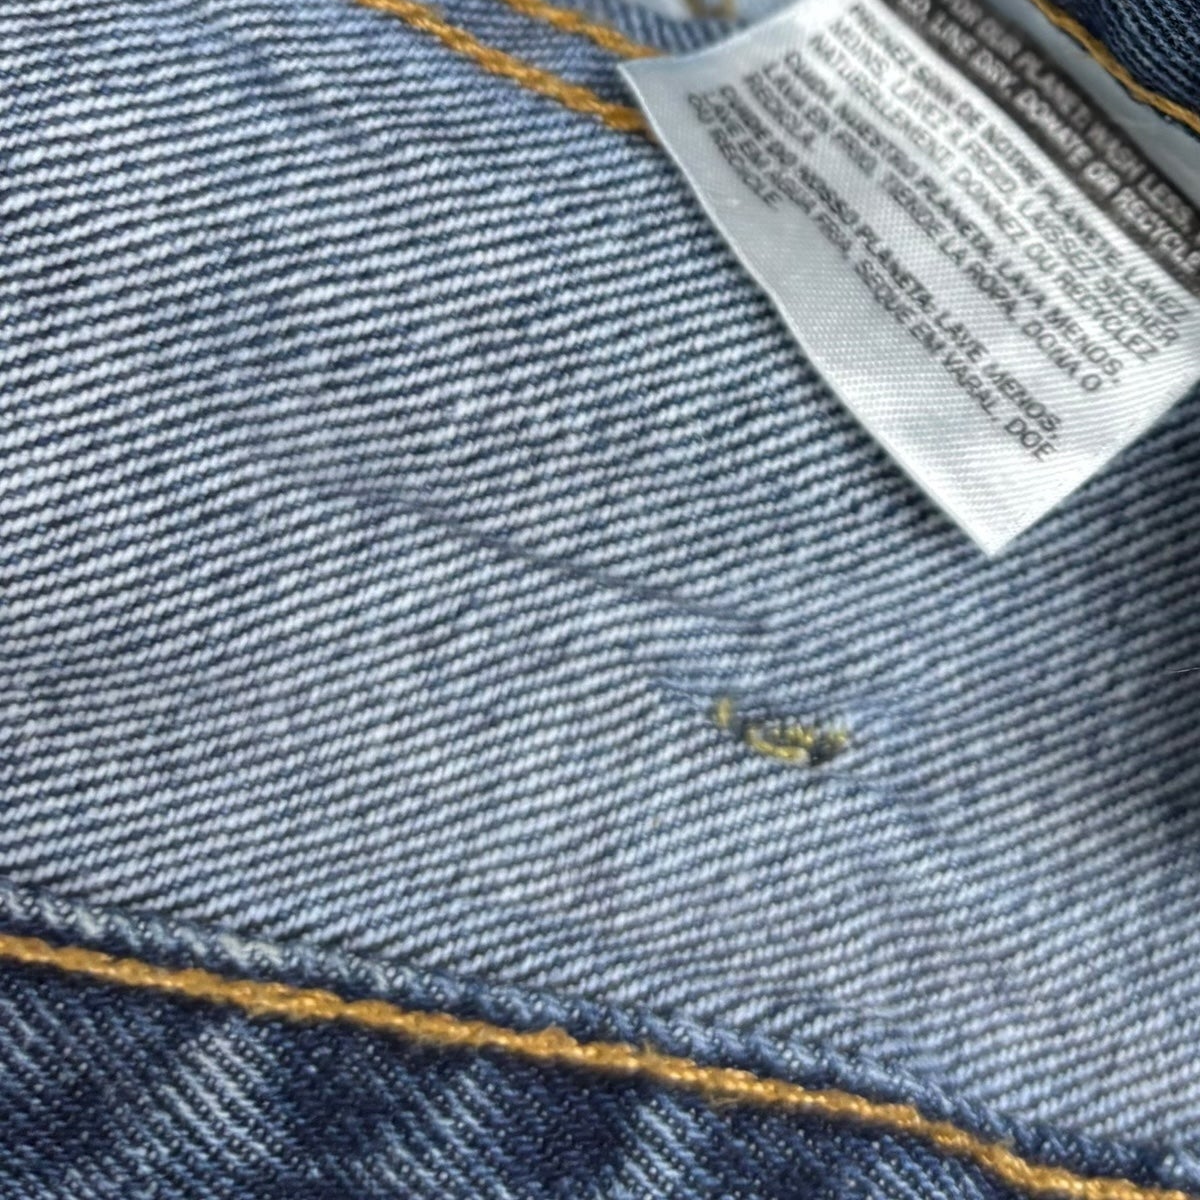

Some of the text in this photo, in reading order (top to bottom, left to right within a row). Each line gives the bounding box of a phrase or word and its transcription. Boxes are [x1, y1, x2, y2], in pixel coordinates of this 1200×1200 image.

[1080, 157, 1123, 197] OR
[936, 233, 971, 266] LA
[1020, 316, 1083, 378] DONA
[1076, 368, 1105, 397] O
[994, 256, 1051, 312] LAVA
[1020, 237, 1060, 275] OU
[1049, 266, 1158, 364] RECYCLEZ
[932, 308, 989, 365] LAVE
[908, 318, 947, 356] EM
[1002, 412, 1056, 465] DOE
